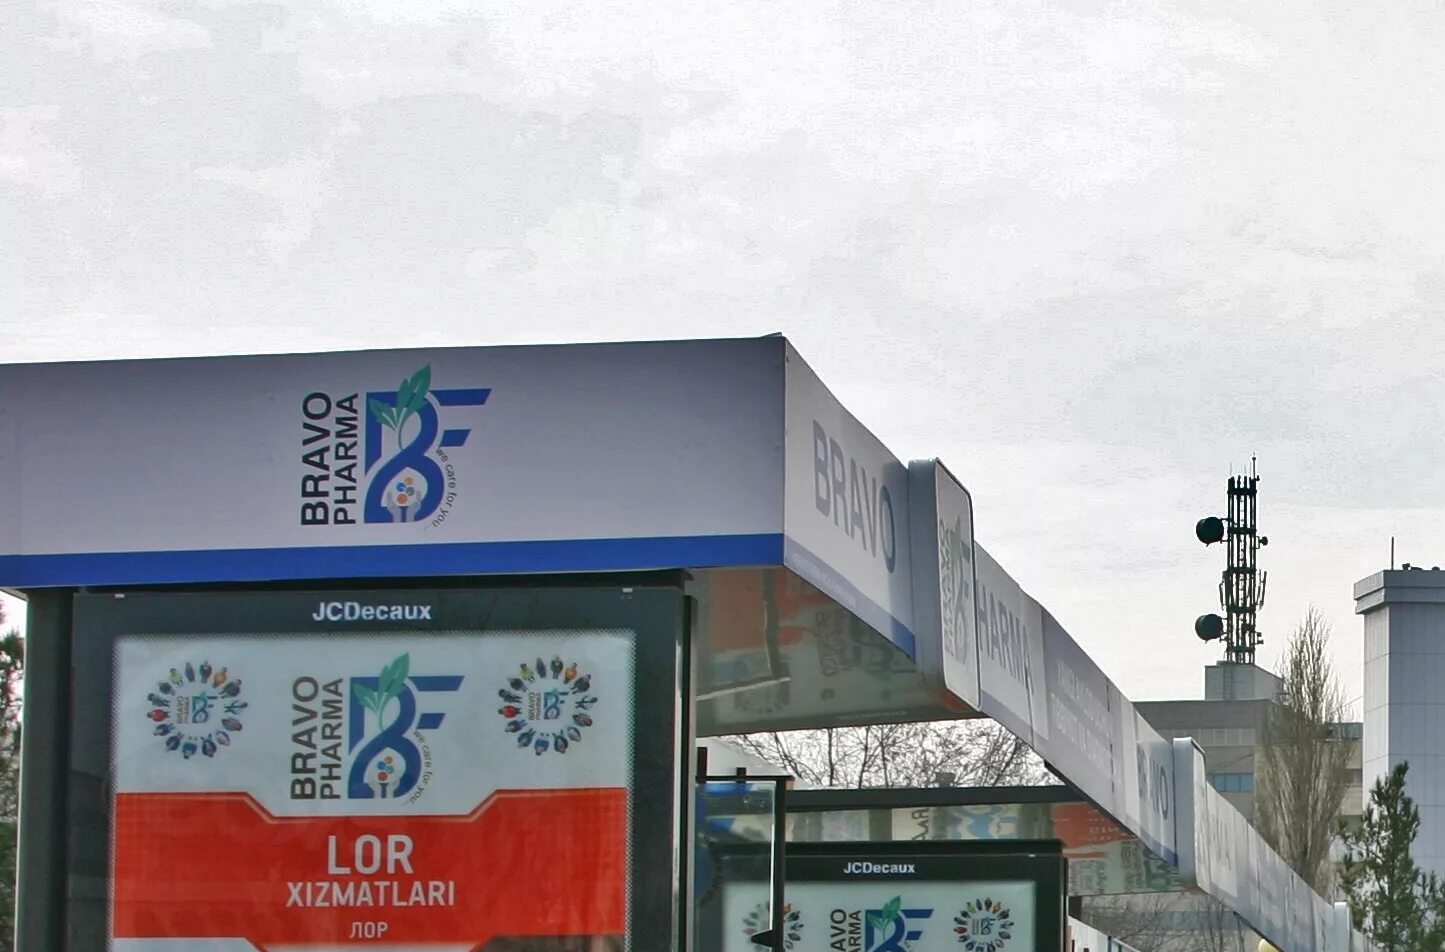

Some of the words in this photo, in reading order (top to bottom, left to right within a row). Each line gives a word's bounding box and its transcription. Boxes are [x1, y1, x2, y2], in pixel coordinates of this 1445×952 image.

[301, 391, 332, 526] BRAVO
[334, 392, 359, 525] PHARMA
[445, 464, 457, 489] care
[812, 418, 897, 575] BRAVO
[312, 601, 432, 622] JCDecaux
[290, 676, 319, 800] BRAVO
[320, 677, 344, 800] PHARMA
[327, 833, 414, 875] LOR
[843, 862, 916, 875] JCDecaux
[286, 880, 456, 908] XIZMATLARI
[350, 921, 388, 939] ЛОР
